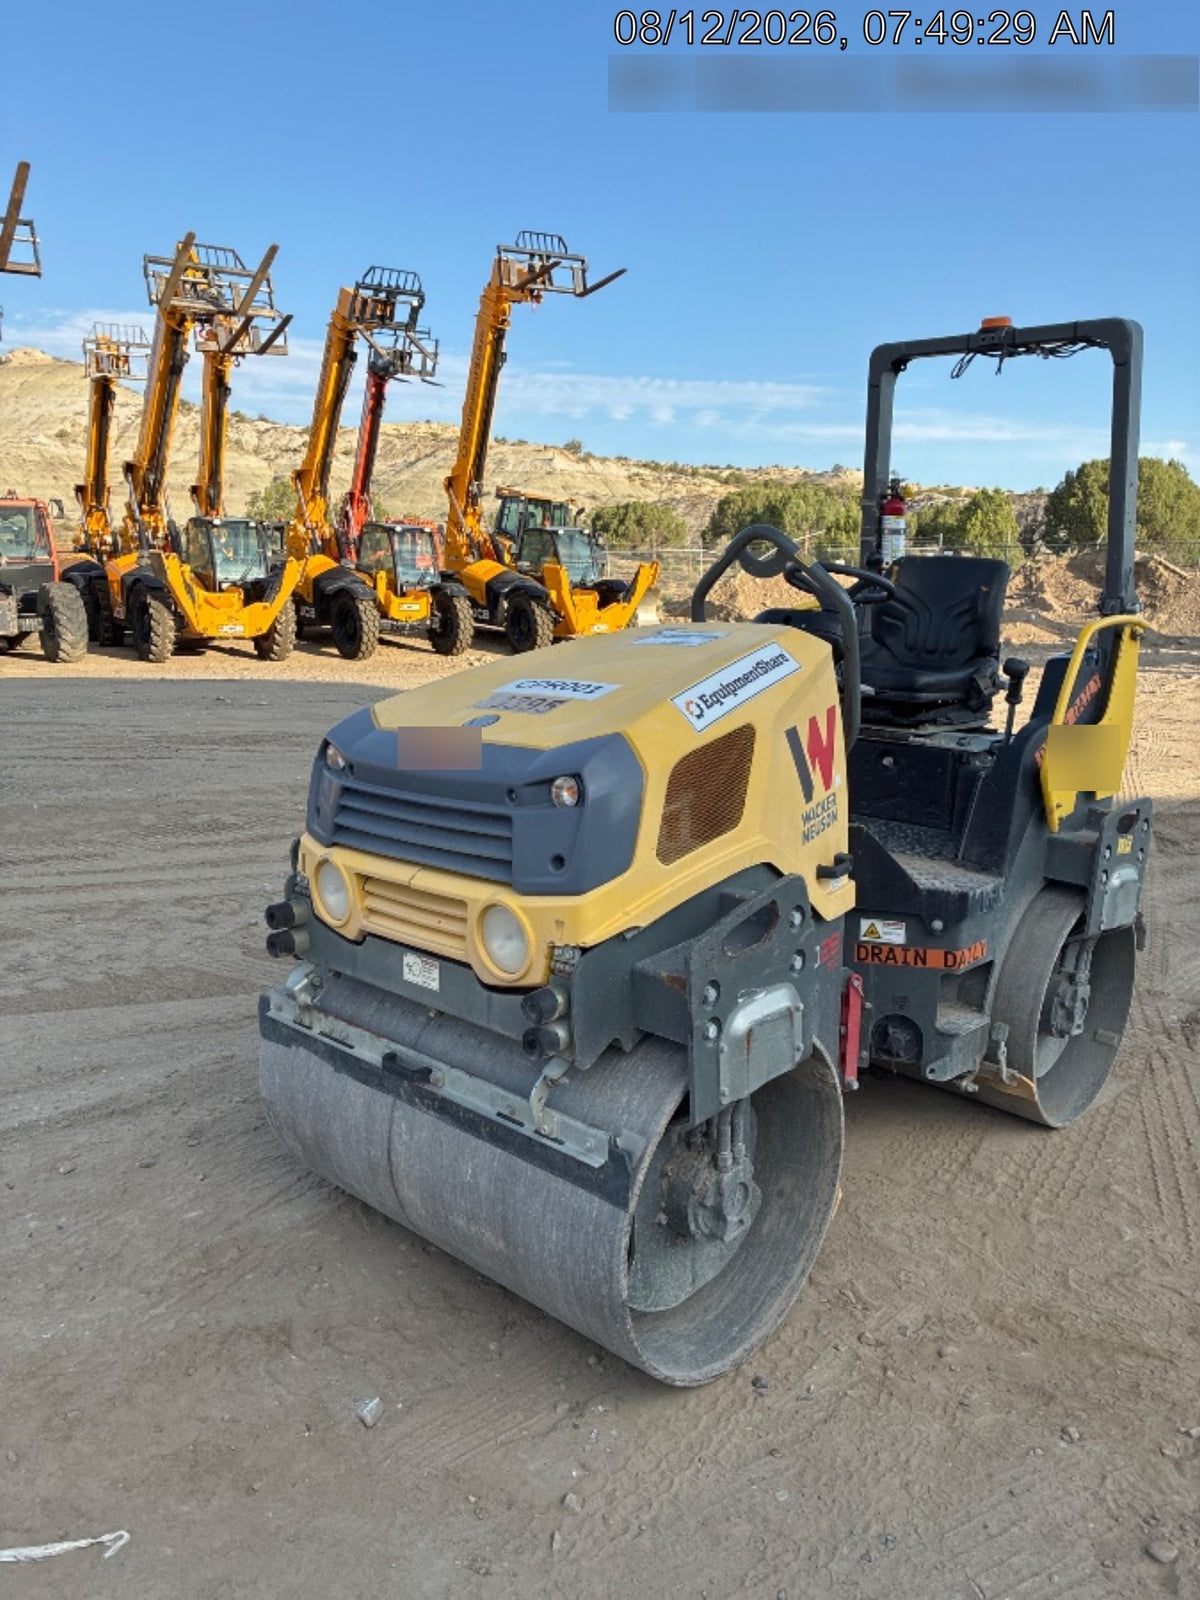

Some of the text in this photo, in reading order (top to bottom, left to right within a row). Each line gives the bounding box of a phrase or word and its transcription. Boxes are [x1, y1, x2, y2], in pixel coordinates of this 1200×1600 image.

[698, 651, 790, 711] EquipmentShare
[801, 792, 837, 827] WACKER
[801, 808, 838, 846] NEUSON
[856, 945, 928, 967] DRAIN
[943, 940, 987, 969] DAILY
